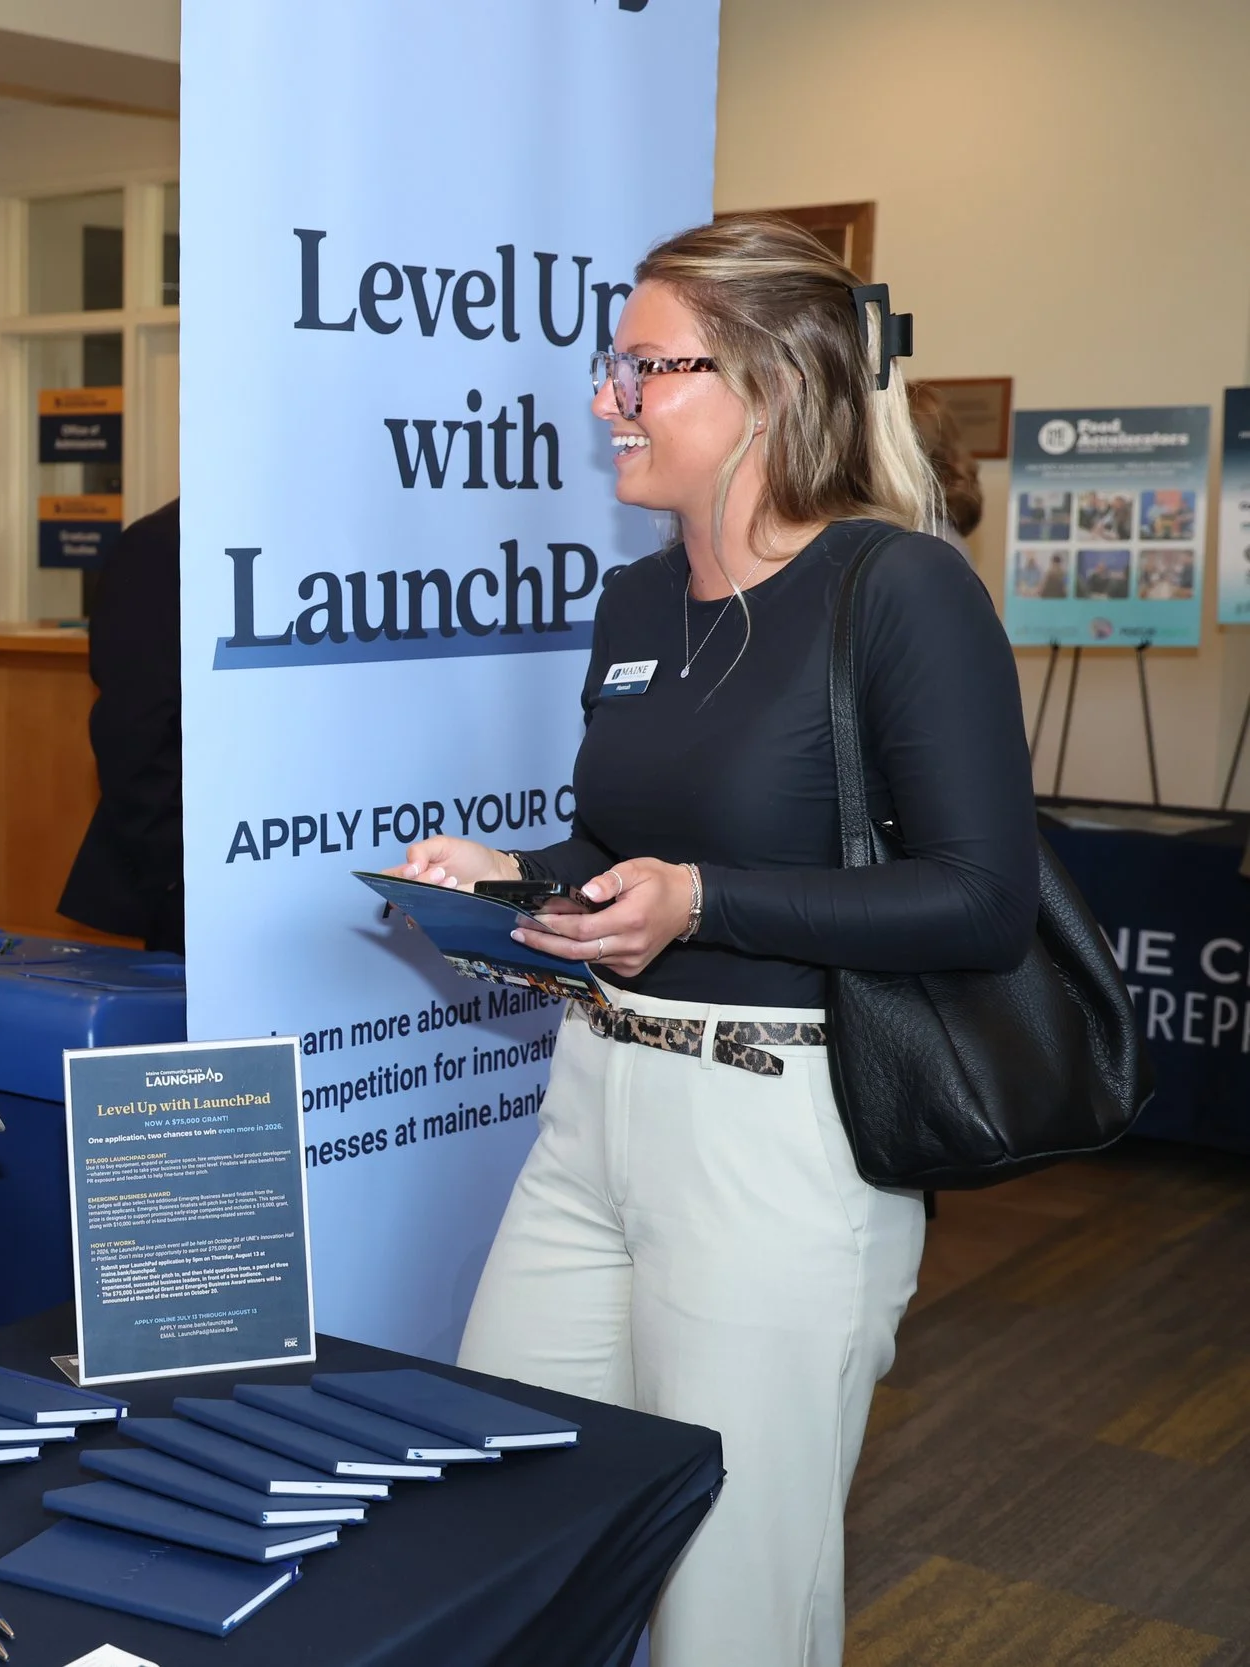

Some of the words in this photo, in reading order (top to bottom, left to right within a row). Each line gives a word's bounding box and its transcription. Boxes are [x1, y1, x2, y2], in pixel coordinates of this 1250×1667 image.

[293, 228, 520, 342] Level
[384, 388, 563, 490] with
[621, 664, 649, 676] MAINE
[226, 809, 362, 863] APPLY
[372, 800, 445, 847] FOR
[453, 788, 547, 836] YOUR
[1200, 937, 1250, 986] C
[351, 1014, 410, 1047] more
[417, 995, 481, 1033] about
[434, 1052, 466, 1083] for
[473, 1030, 557, 1075] innovati
[145, 1066, 223, 1087] LAUNCHPAD
[97, 1102, 134, 1118] Level
[137, 1100, 156, 1115] Up
[159, 1097, 191, 1113] with
[193, 1092, 270, 1111] LaunchPad
[87, 1136, 103, 1145] One
[104, 1133, 146, 1143] application,
[147, 1132, 161, 1140] two
[162, 1129, 192, 1139] chances
[193, 1128, 202, 1137] to
[203, 1127, 216, 1136] win
[217, 1126, 235, 1135] even
[236, 1124, 255, 1133] more
[256, 1124, 263, 1132] in
[264, 1122, 283, 1131] 2026.
[144, 1119, 163, 1128] NOW
[171, 1117, 200, 1126] $75,000
[201, 1114, 228, 1123] GRANT!
[395, 1116, 417, 1147] at
[284, 1339, 297, 1347] FDIC
